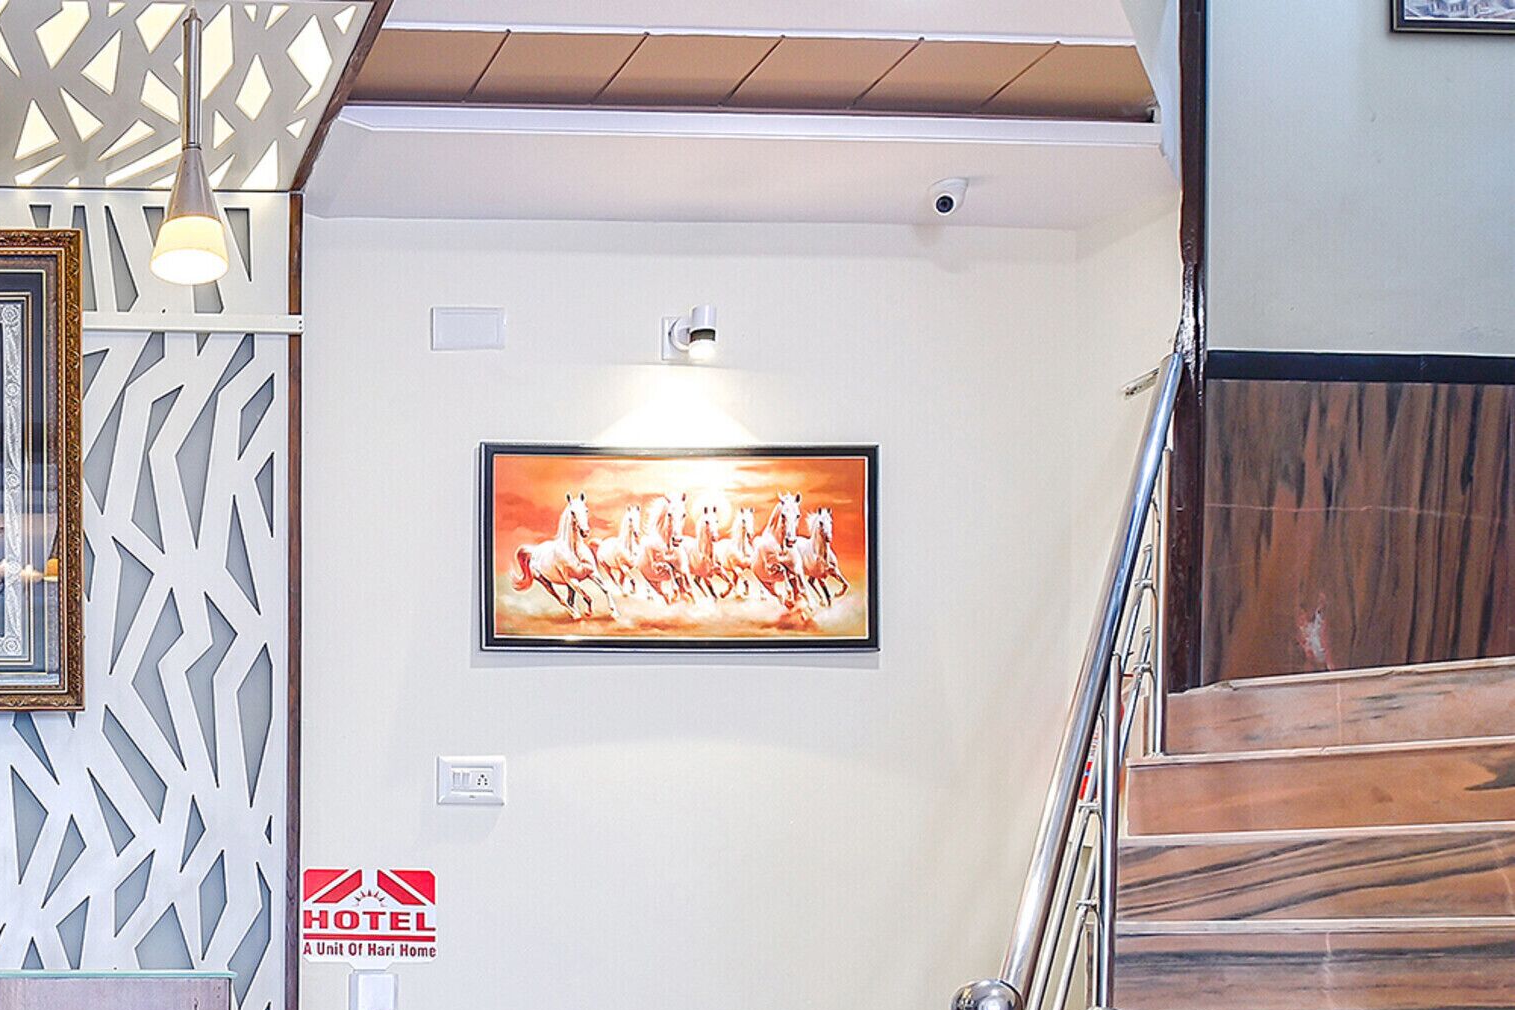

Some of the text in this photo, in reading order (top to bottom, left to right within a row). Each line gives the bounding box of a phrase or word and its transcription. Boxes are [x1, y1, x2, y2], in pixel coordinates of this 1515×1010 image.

[303, 910, 436, 930] HOTEL
[303, 943, 436, 958] A Unit Of Hari Home
